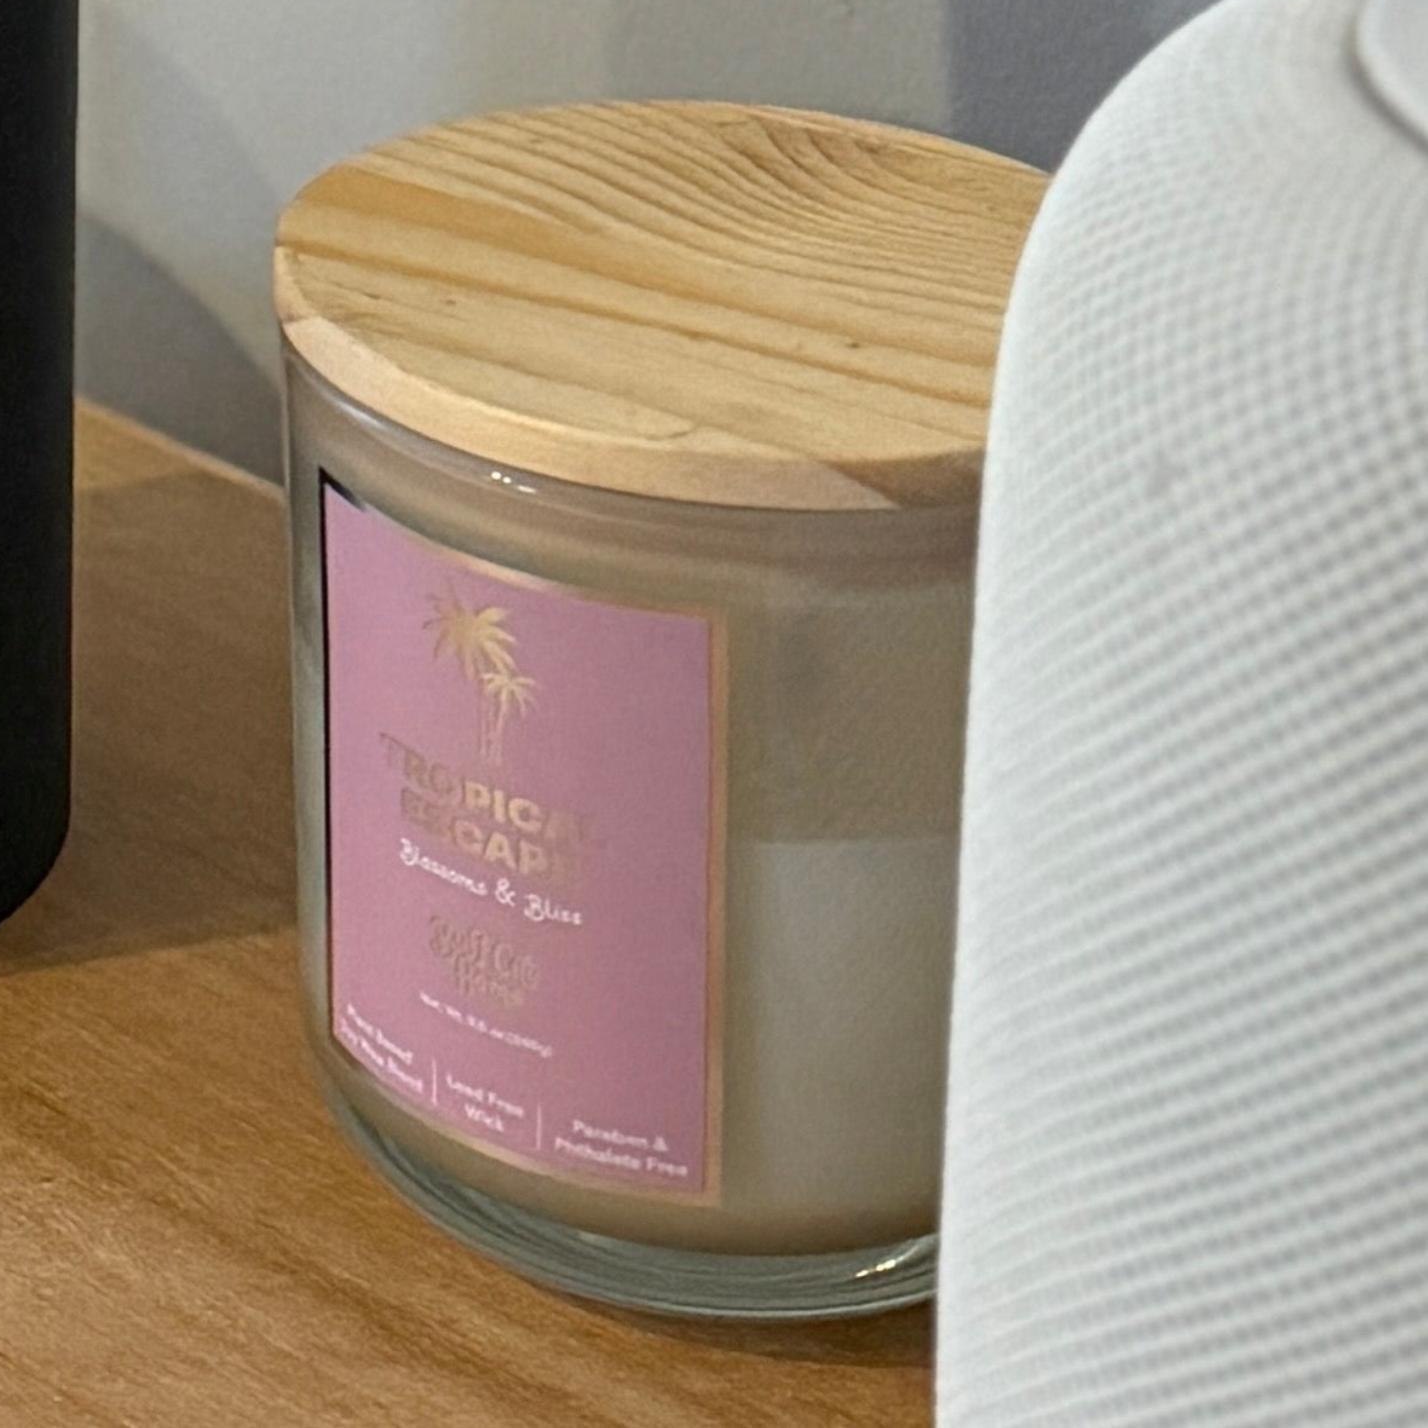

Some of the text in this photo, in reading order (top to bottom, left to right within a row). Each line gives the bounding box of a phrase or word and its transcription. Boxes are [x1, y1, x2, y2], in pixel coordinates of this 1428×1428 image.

[379, 731, 588, 844] TROPICA
[399, 837, 583, 927] Blossoms & Bliss
